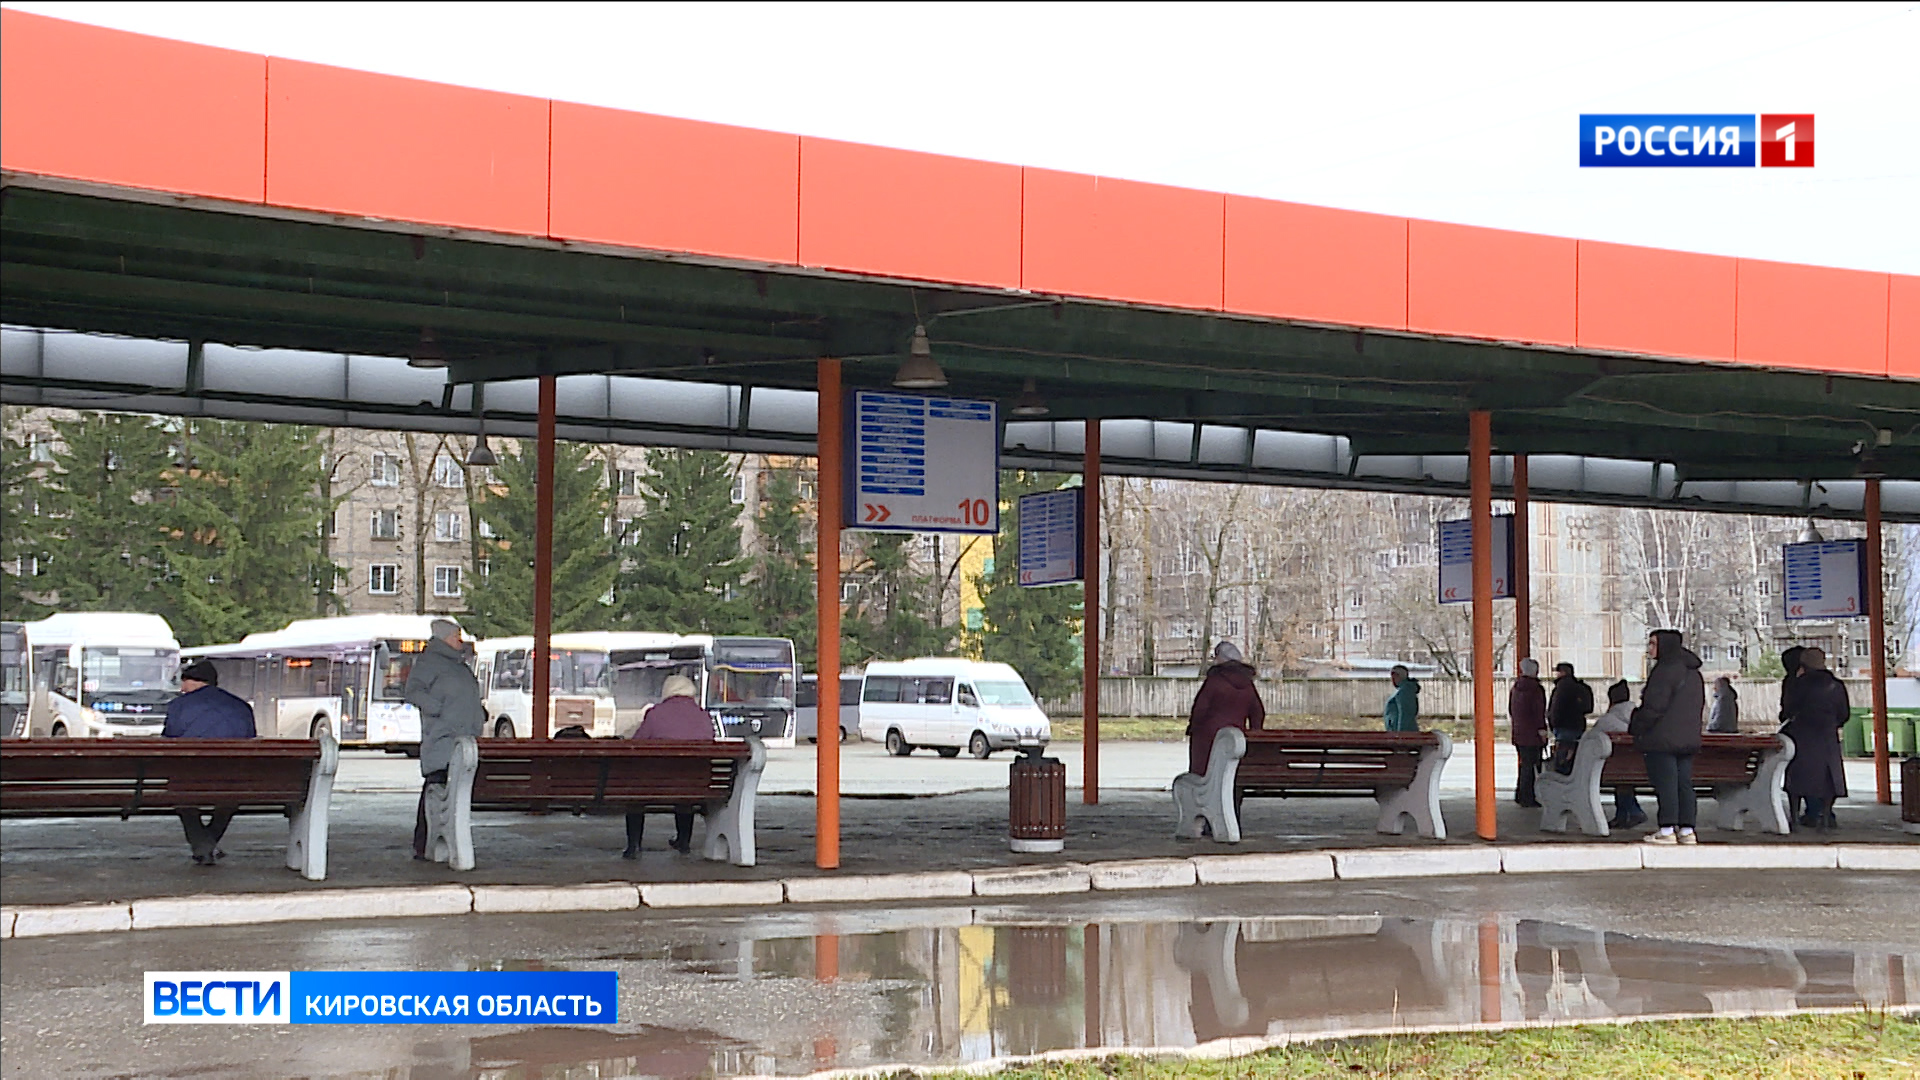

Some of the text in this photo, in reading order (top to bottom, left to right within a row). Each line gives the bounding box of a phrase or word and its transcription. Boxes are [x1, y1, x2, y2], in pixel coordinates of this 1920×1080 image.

[911, 498, 990, 526] ПЛАТФОРМА 10
[1495, 578, 1504, 594] 2
[1847, 596, 1855, 612] 3
